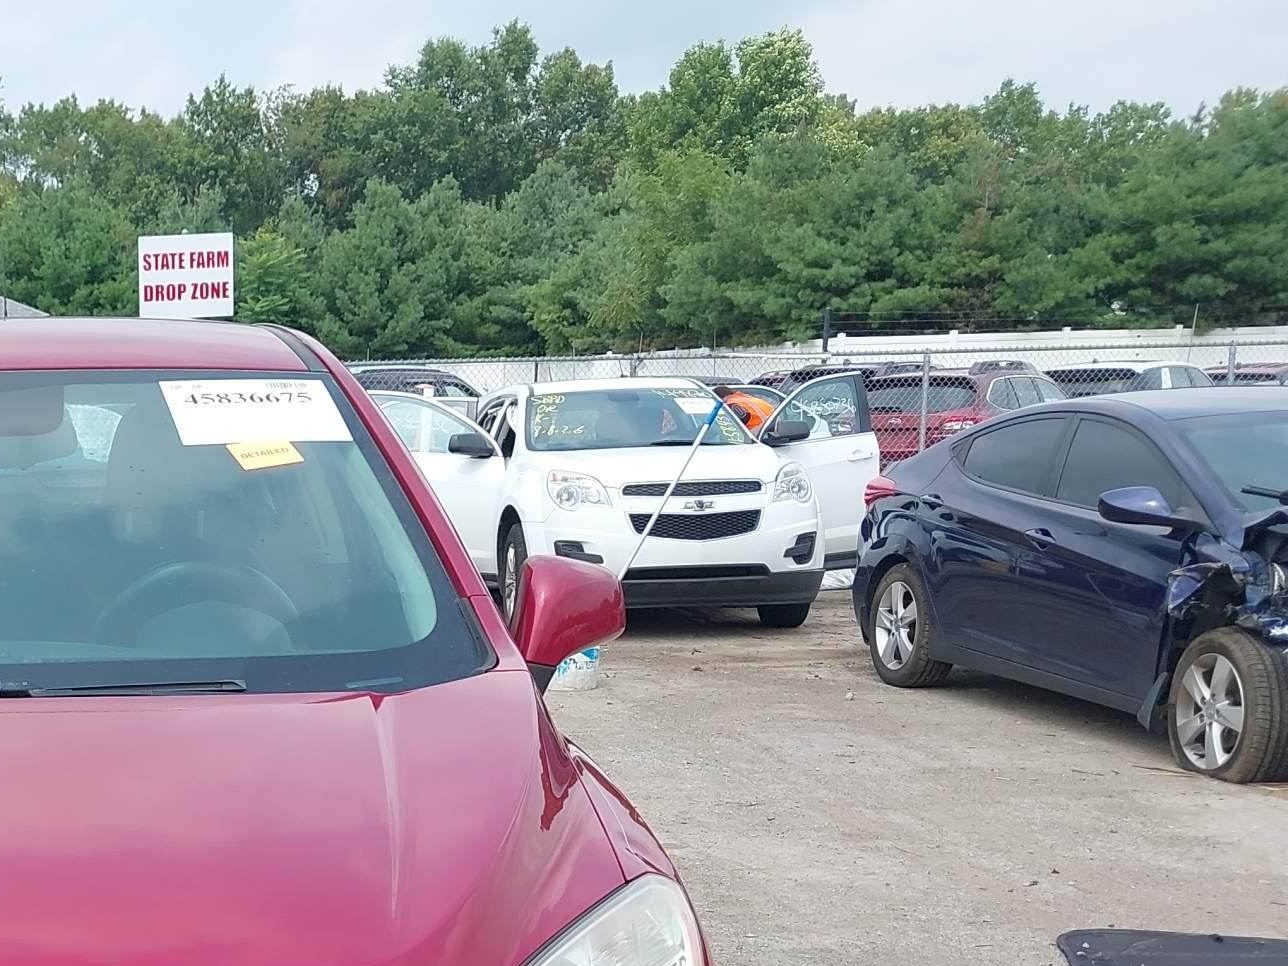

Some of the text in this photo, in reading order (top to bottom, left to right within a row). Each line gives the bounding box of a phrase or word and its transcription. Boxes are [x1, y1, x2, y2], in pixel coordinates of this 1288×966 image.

[143, 250, 229, 271] STATE FARM
[143, 281, 230, 302] DROP ZONE
[184, 392, 312, 405] 45836675
[240, 446, 289, 460] DETAILED
